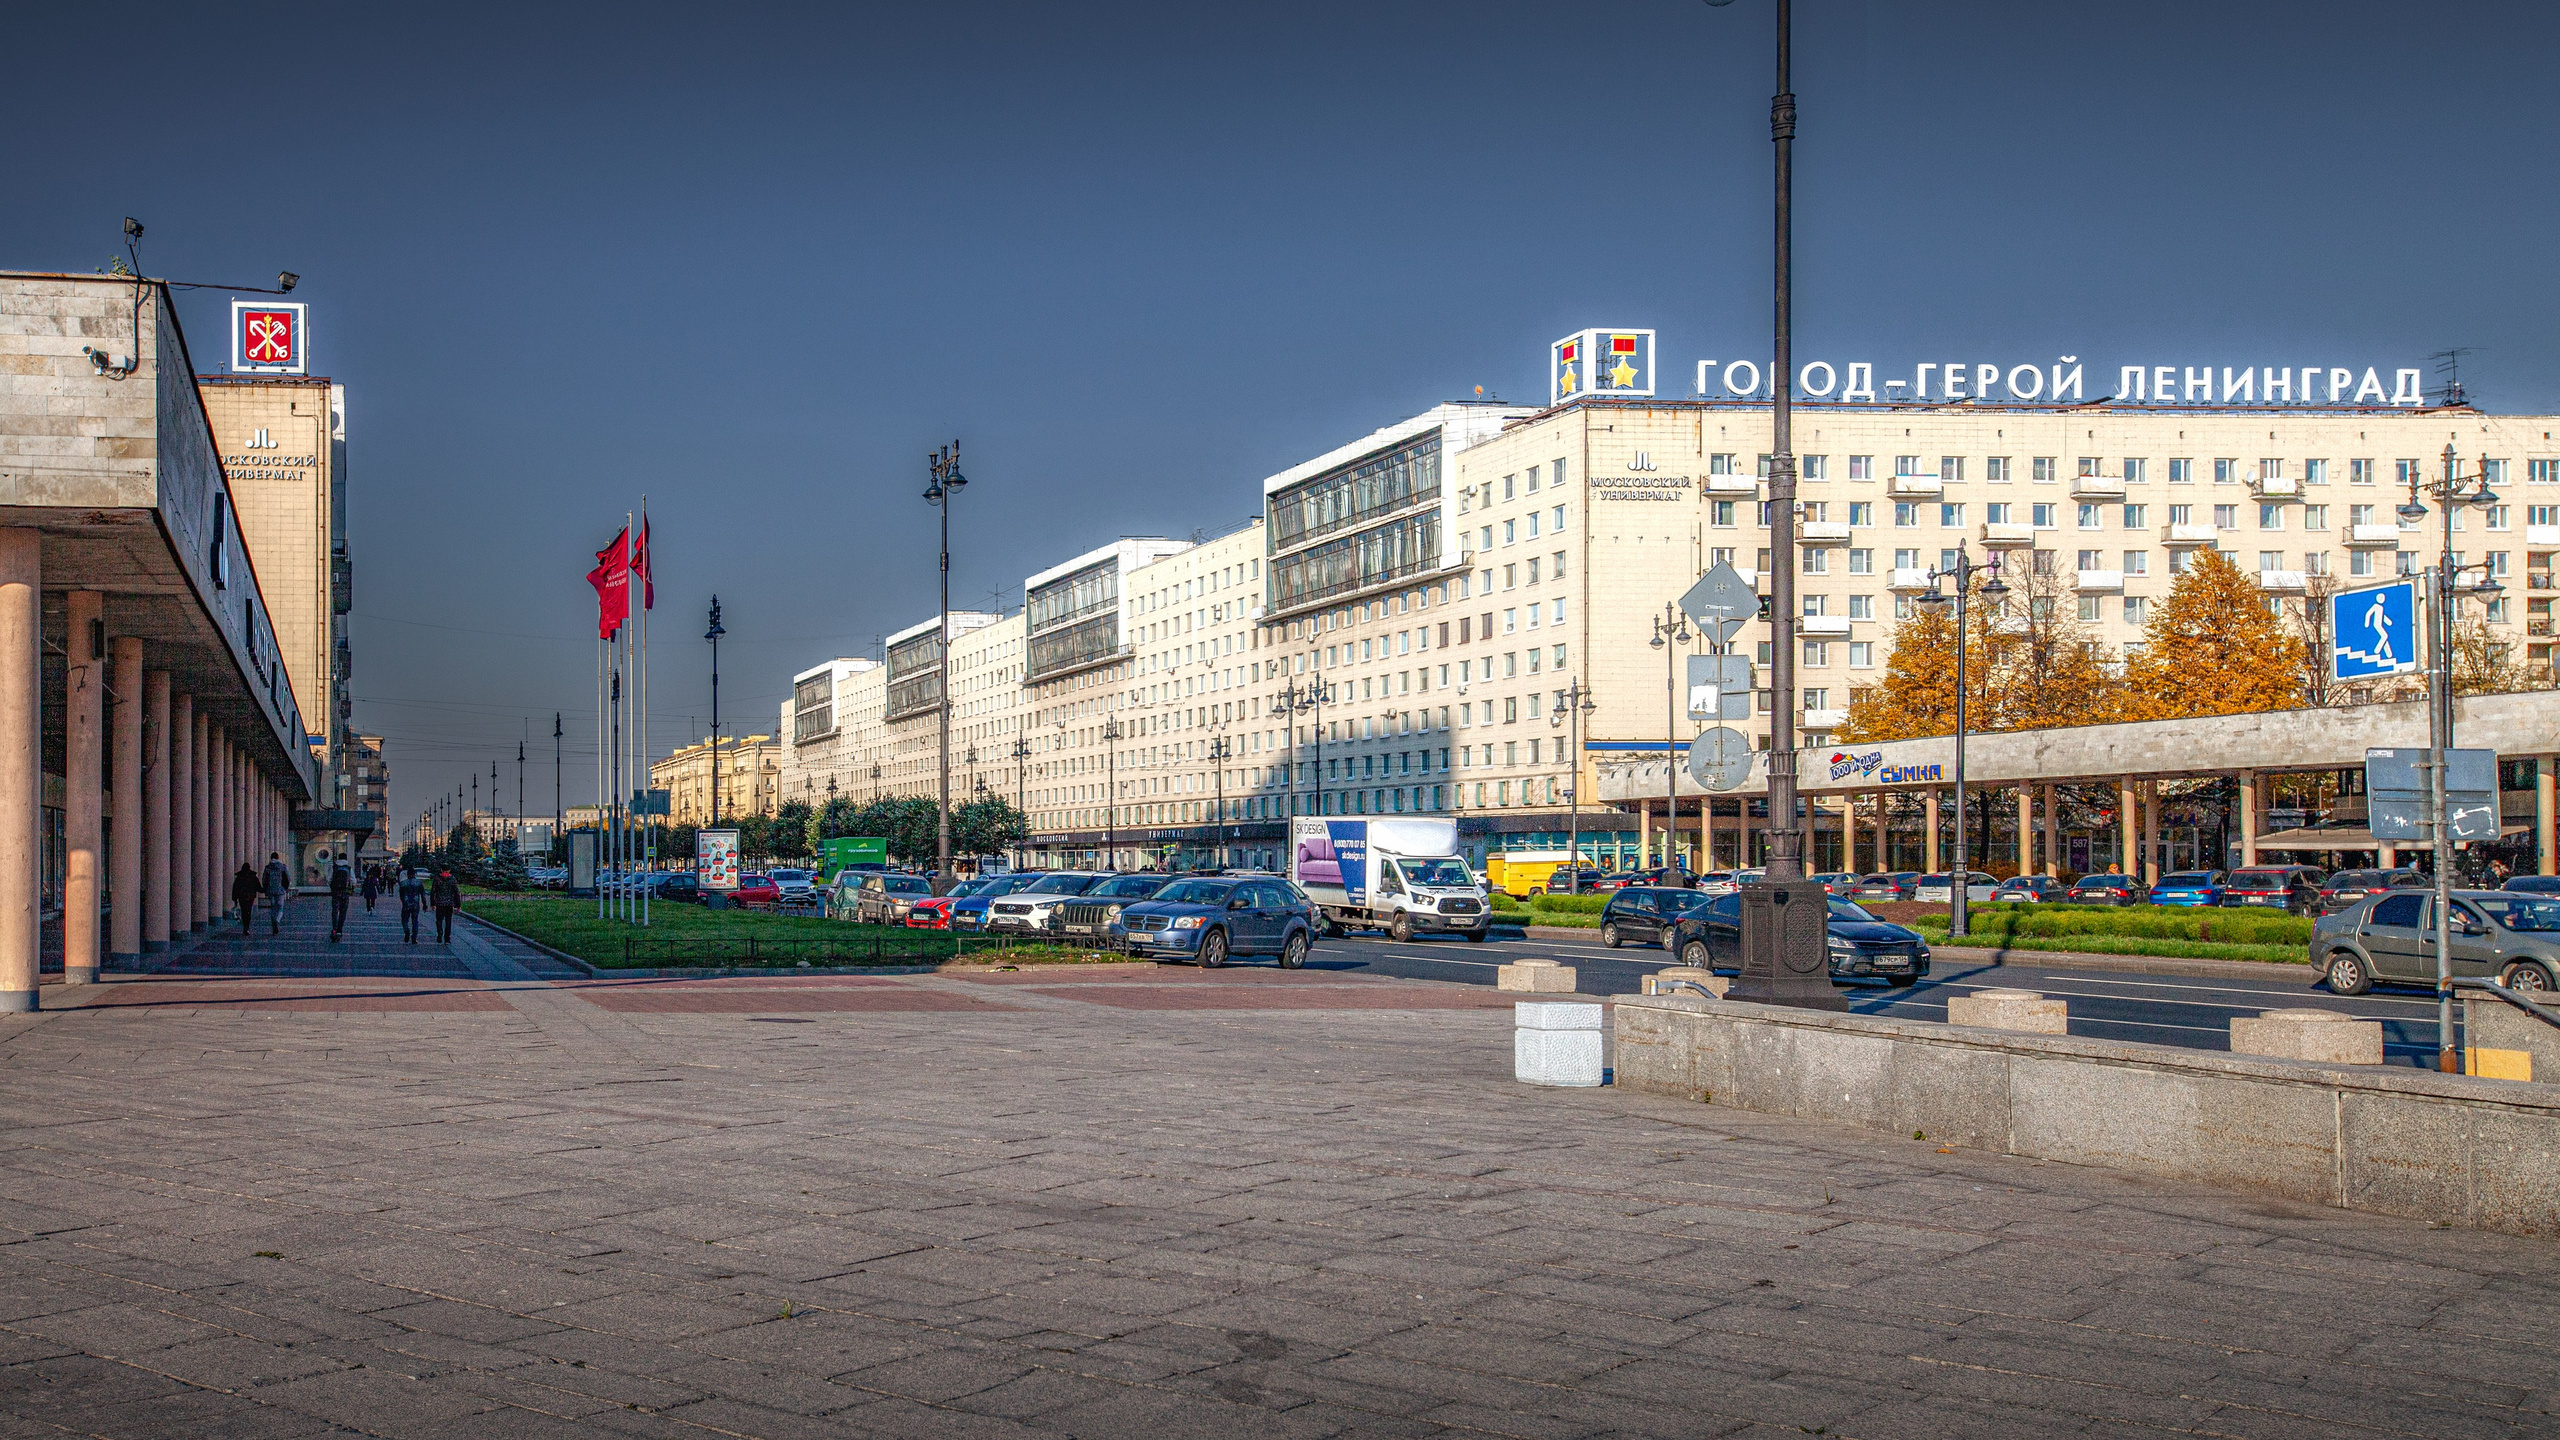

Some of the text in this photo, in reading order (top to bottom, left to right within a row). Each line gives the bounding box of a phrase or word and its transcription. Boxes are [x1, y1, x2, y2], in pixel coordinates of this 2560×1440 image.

[1697, 355, 2425, 407] ГООД-ГЕРОЙ ЛЕНИНГРАД
[220, 455, 317, 468] ОСКОВСКИЙ
[225, 469, 306, 481] НИВЕРМАГ
[1590, 476, 1692, 488] МОСКОВСКИЙ
[1600, 490, 1683, 501] УНИВЕРМАГ
[1829, 751, 1882, 781] 1000 И ОДНА
[1880, 764, 1944, 783] СУМКА
[1149, 830, 1185, 839] УНИВЕРМАГ
[1296, 823, 1326, 835] SK DESIGN
